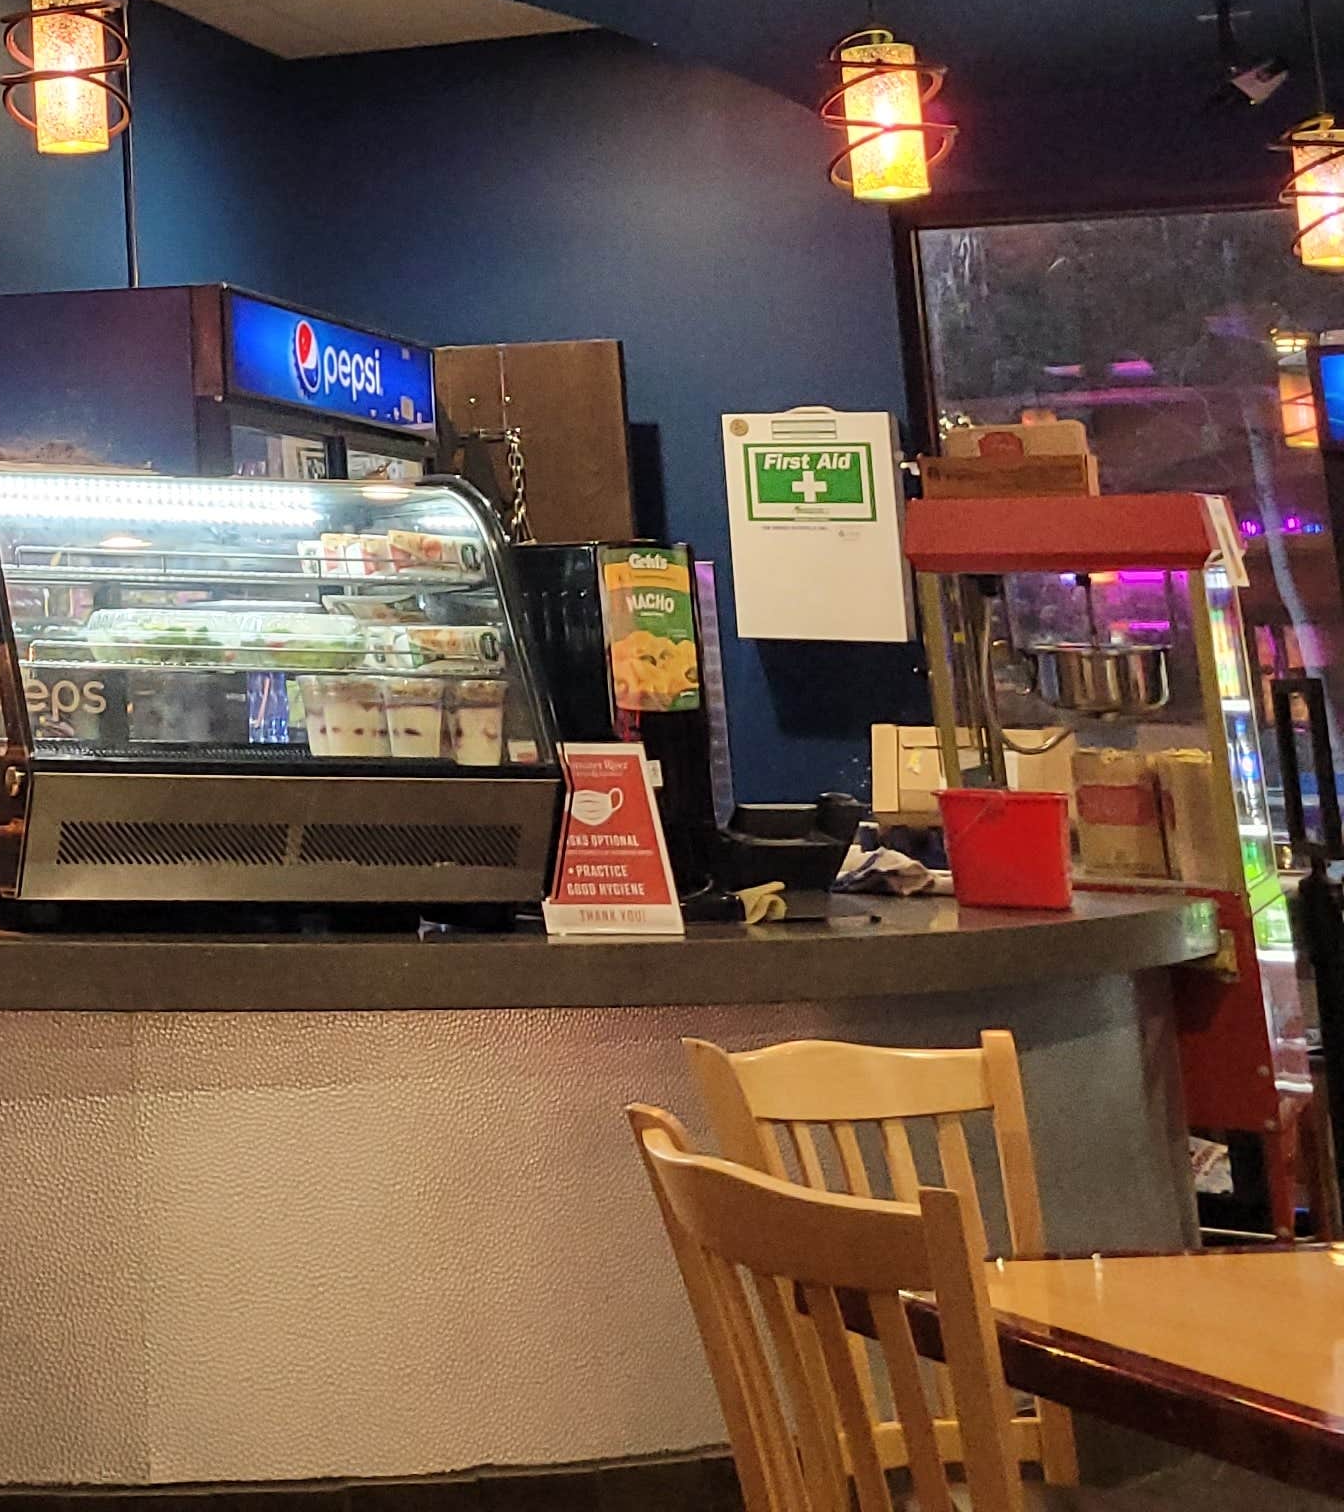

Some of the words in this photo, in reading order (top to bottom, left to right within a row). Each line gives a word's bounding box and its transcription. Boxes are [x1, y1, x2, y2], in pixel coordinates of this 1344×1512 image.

[323, 346, 382, 402] pepsi
[763, 453, 811, 470] First
[816, 453, 852, 470] Aid
[625, 593, 675, 613] NACHO
[590, 834, 640, 847] OPTIONAL
[575, 864, 629, 878] PRACTICE
[567, 883, 596, 896] GOOD
[598, 883, 646, 896] HYGIENE
[578, 908, 616, 922] THANK
[619, 909, 647, 922] YOU!
